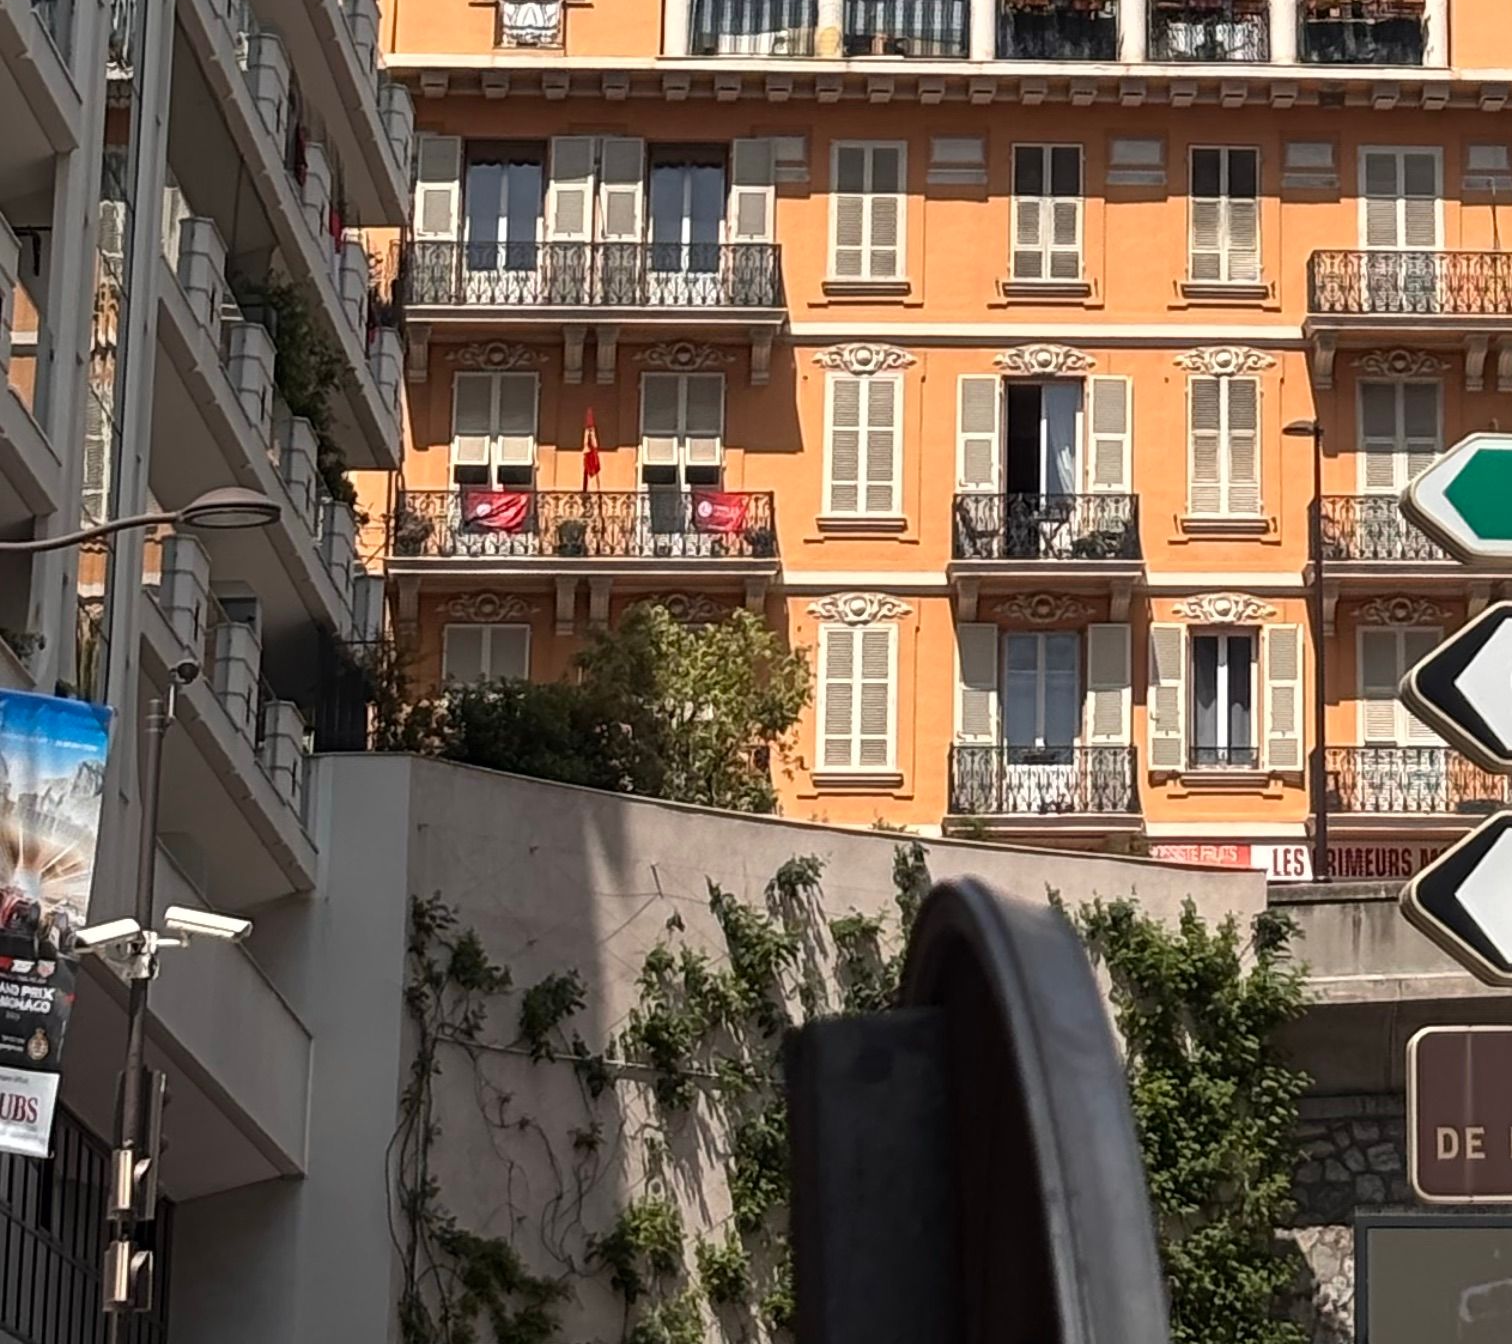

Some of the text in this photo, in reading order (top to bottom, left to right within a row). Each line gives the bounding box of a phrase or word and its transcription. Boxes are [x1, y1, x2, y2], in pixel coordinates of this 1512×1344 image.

[1272, 847, 1304, 876] LES
[1312, 847, 1413, 877] RIMEURS
[0, 1092, 38, 1125] UBS
[1436, 1126, 1486, 1160] DE
